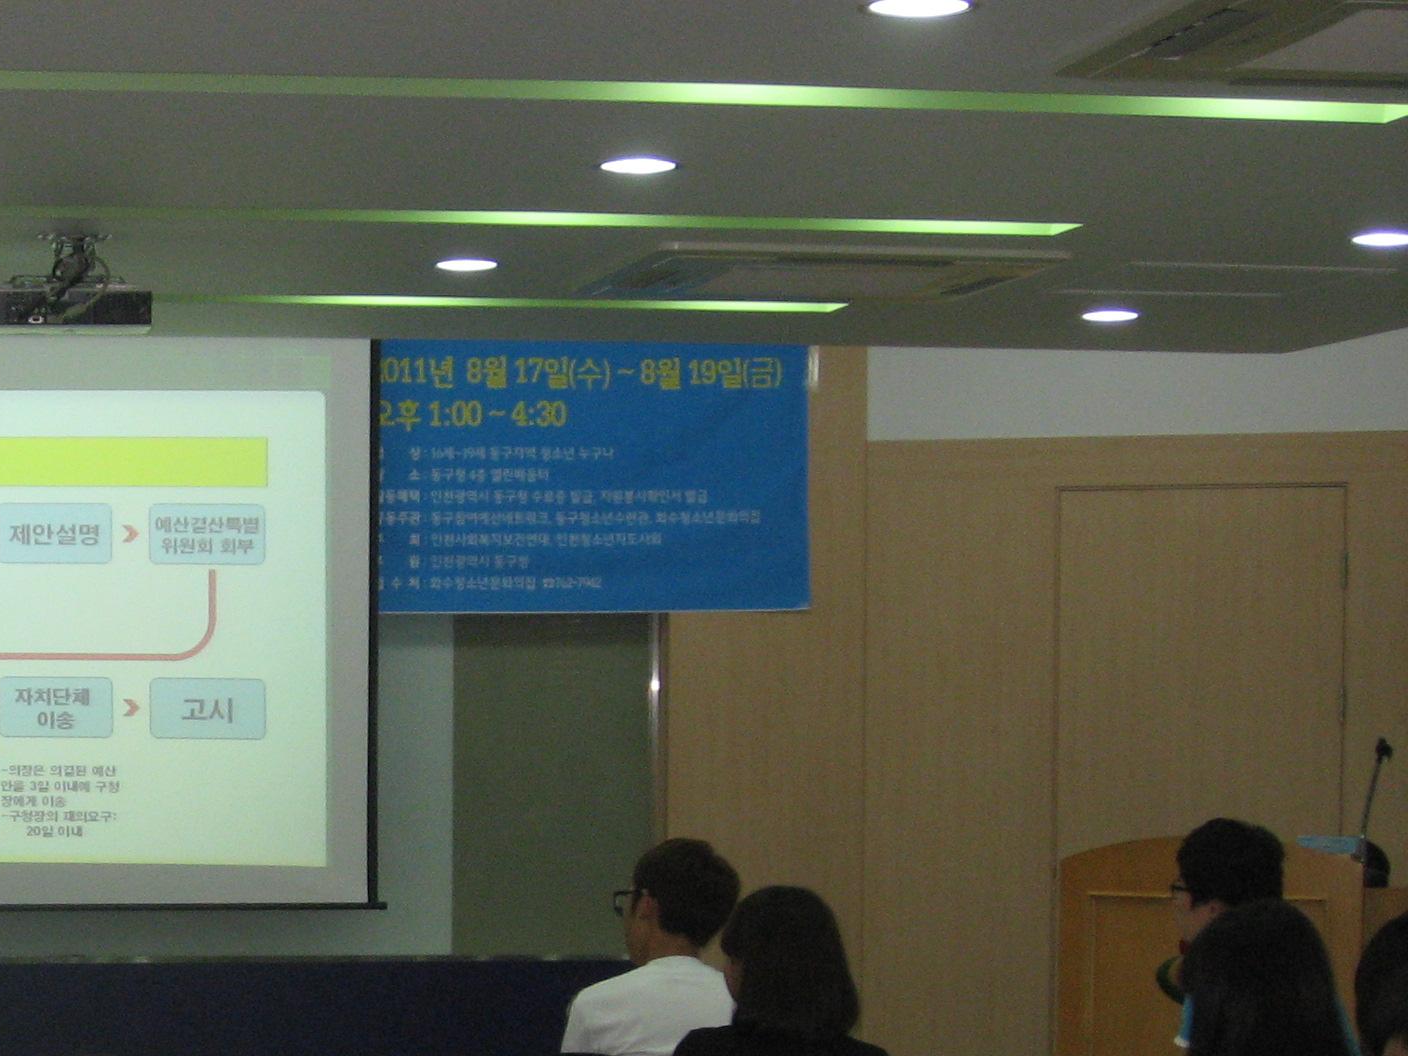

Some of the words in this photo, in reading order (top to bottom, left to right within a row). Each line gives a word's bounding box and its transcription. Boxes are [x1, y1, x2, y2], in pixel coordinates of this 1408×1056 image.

[380, 356, 453, 388] 011년
[467, 357, 507, 388] 8월
[516, 357, 610, 390] 17일(수)
[640, 358, 681, 390] 8월
[689, 358, 783, 389] 19일(금)
[429, 401, 482, 427] 1:00
[511, 401, 568, 427] 4:30
[154, 516, 261, 534] 예산결산특별
[8, 523, 101, 546] 제안설명
[160, 537, 213, 555] 위원회
[220, 537, 254, 555] 회부
[15, 688, 90, 706] 자치단체
[181, 698, 234, 724] 고시
[37, 711, 75, 730] 이송
[92, 765, 116, 777] 예산
[30, 780, 49, 792] 3일
[95, 780, 120, 793] 구청
[43, 795, 67, 807] 이송
[27, 826, 54, 838] 20일
[58, 826, 83, 838] 이내
